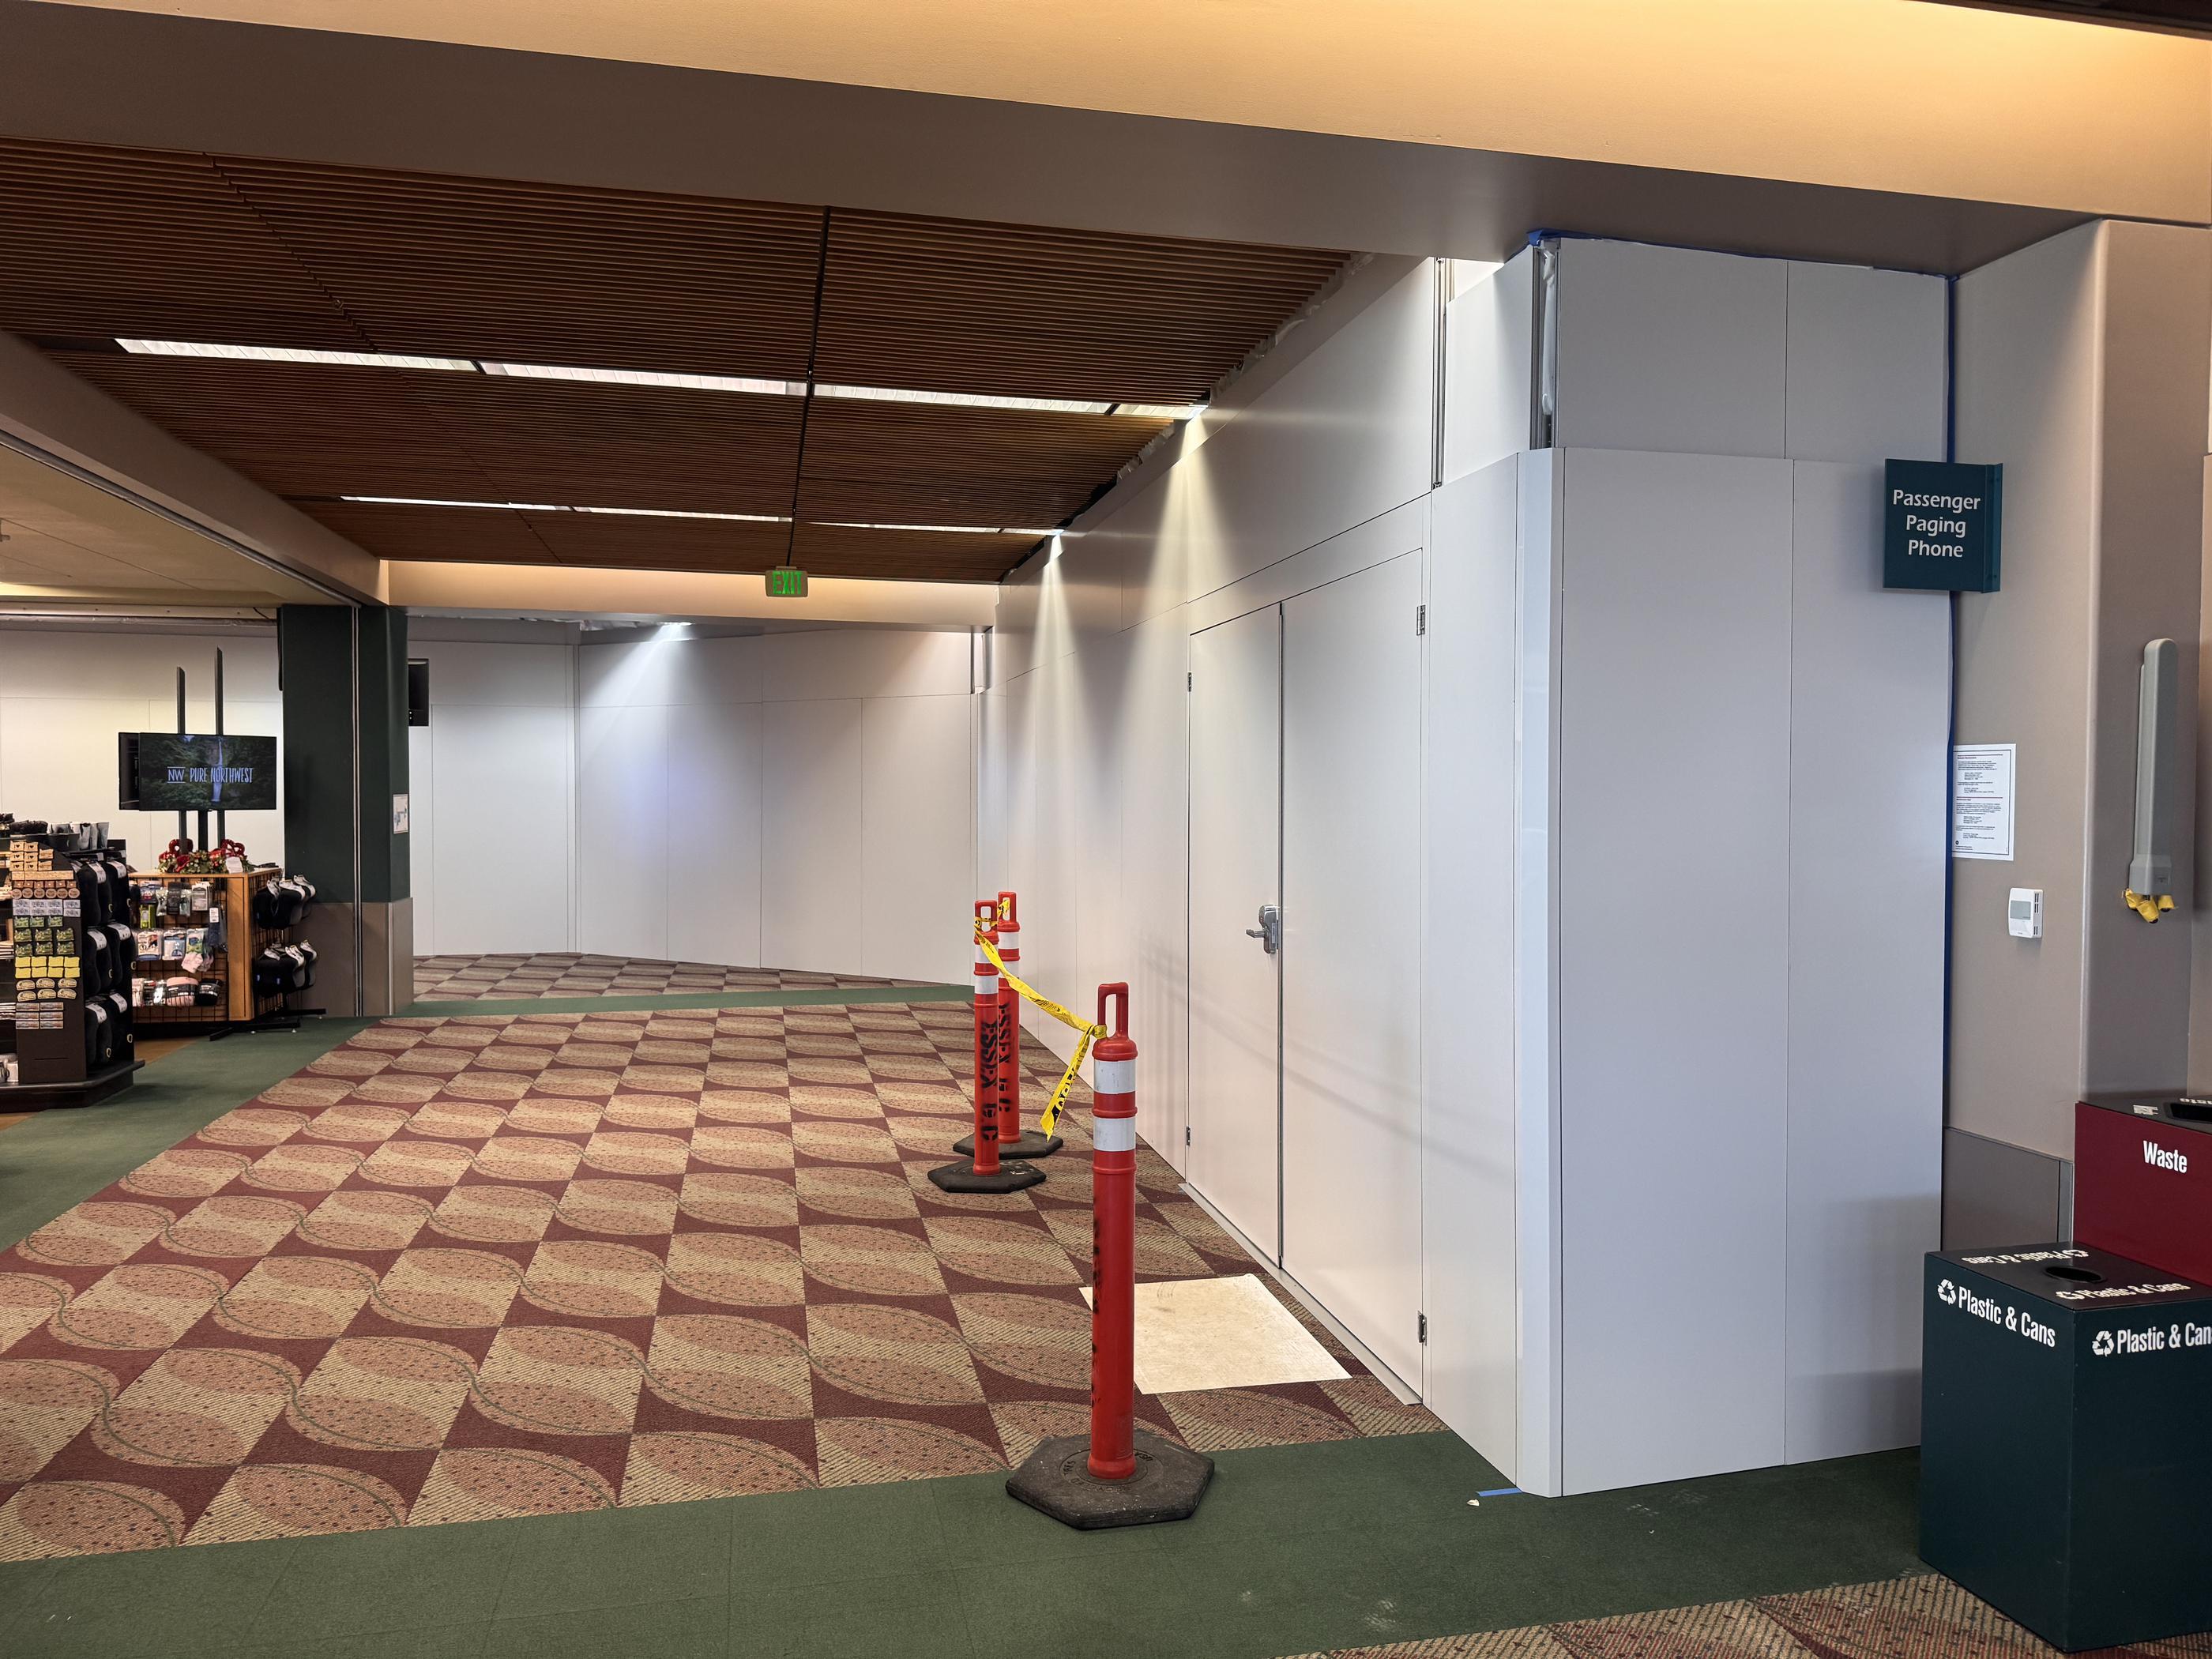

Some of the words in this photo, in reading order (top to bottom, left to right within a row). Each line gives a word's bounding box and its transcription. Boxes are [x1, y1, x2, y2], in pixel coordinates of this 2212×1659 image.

[1893, 489, 1981, 514] Passenger
[1906, 515, 1966, 538] Paging
[1908, 540, 1963, 558] Phone
[773, 570, 803, 595] EXIT
[167, 769, 185, 781] NW
[190, 767, 207, 783] PURE
[210, 767, 253, 783] NORTHWEST
[2142, 1140, 2188, 1173] Waste
[2075, 1287, 2136, 1298] Plastic
[2142, 1283, 2191, 1292] Cans
[1958, 1285, 2002, 1325] Plastic
[2005, 1306, 2017, 1332] &
[2021, 1311, 2056, 1347] Cans
[2116, 1326, 2165, 1354] Plastic
[2169, 1324, 2181, 1349] &
[2185, 1322, 2212, 1347] Can
